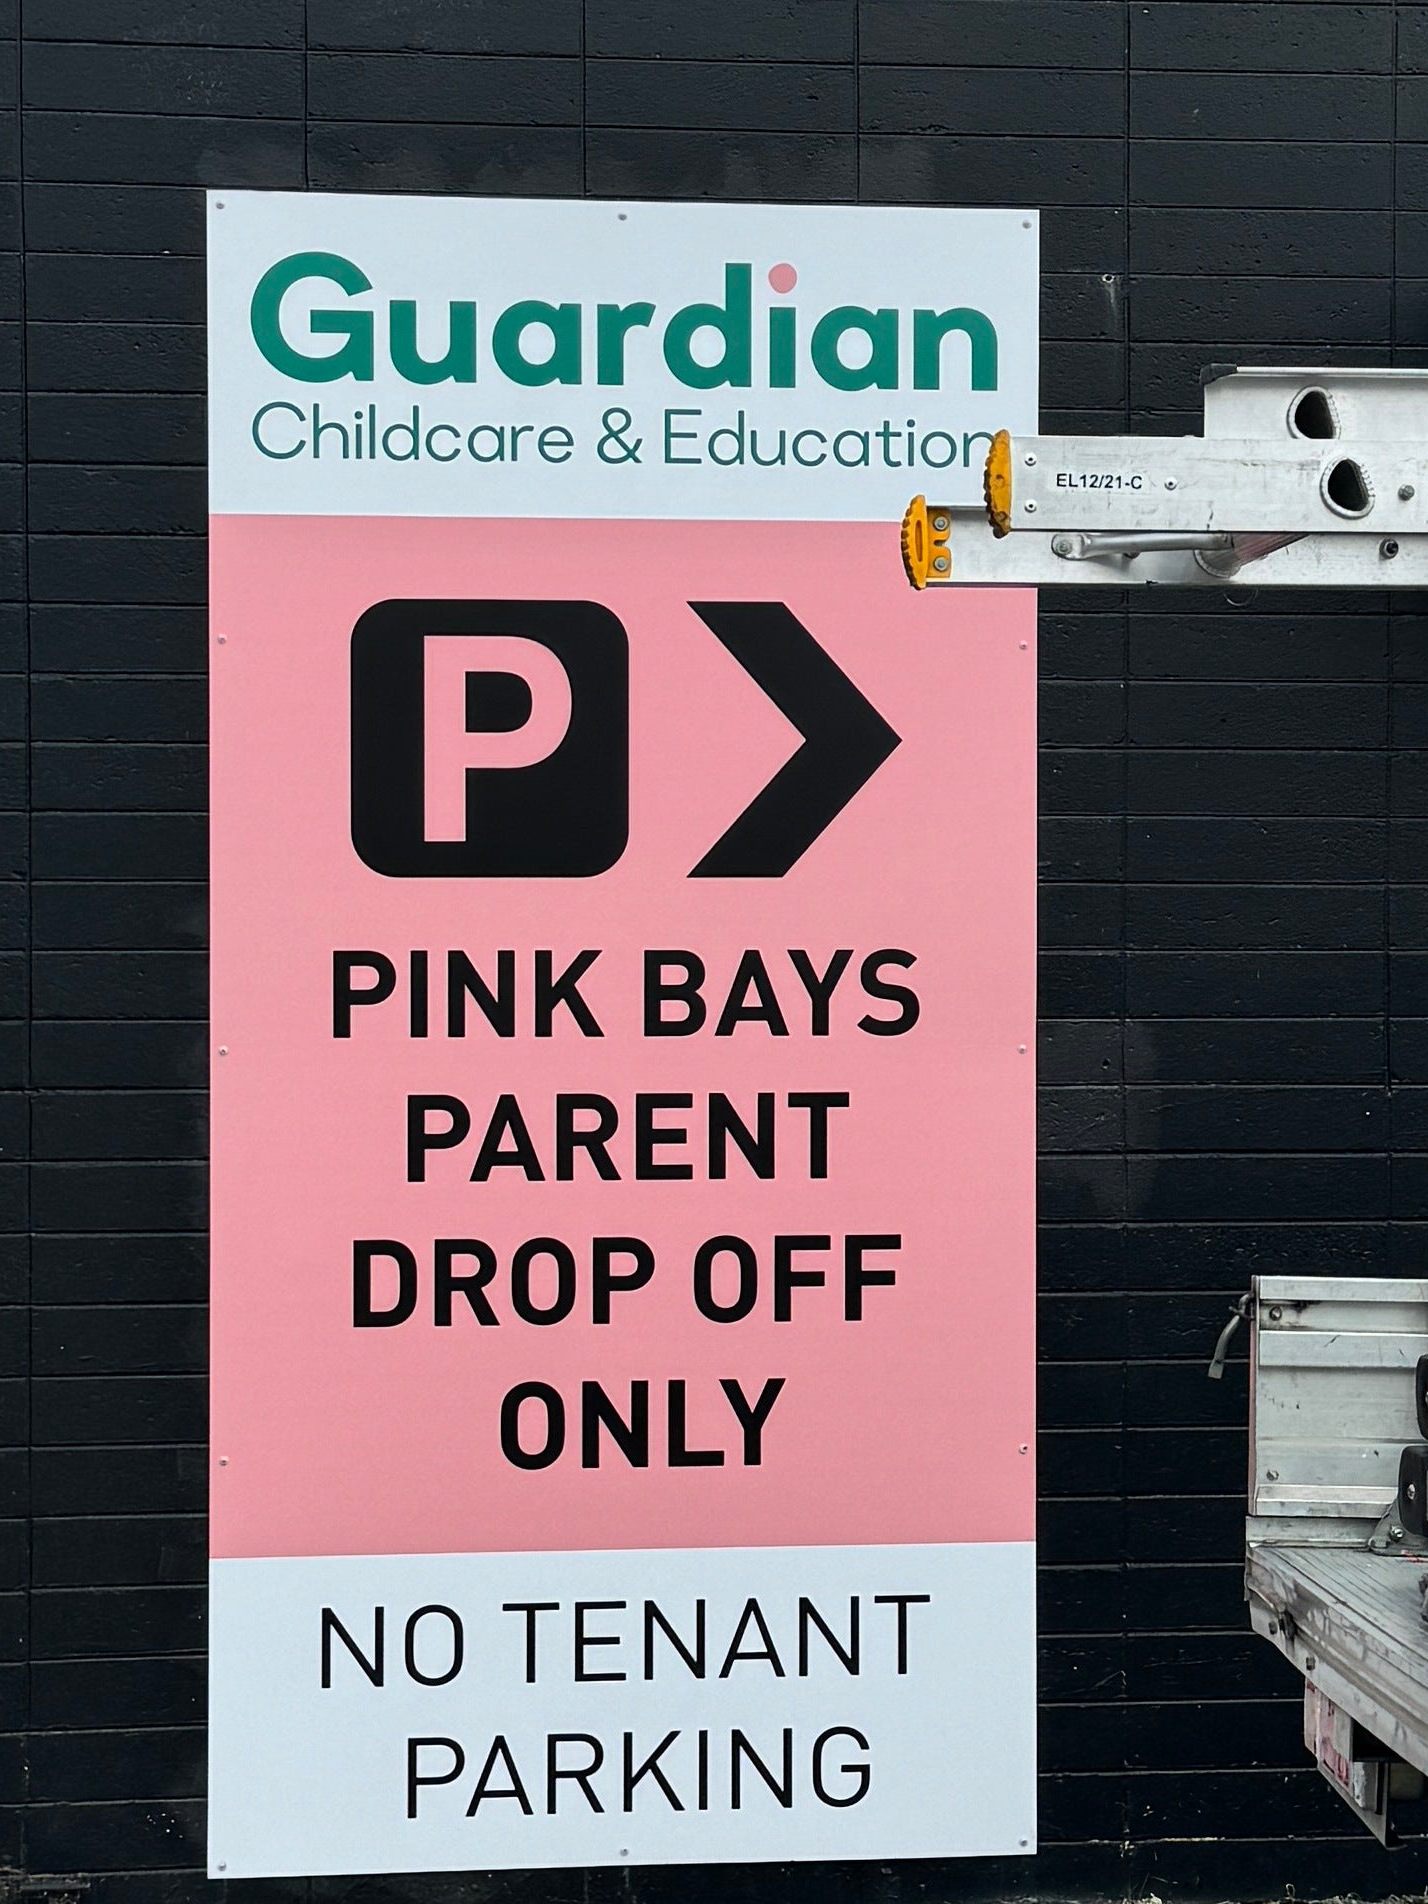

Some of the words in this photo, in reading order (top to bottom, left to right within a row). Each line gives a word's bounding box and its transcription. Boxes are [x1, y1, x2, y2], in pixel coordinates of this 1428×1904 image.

[251, 252, 997, 391] Guardian
[252, 402, 574, 463] Childcare
[597, 408, 642, 464] &
[665, 409, 994, 468] Education
[1057, 473, 1143, 490] EL12/21-C
[424, 636, 572, 842] P
[332, 949, 604, 1038] PINK
[643, 948, 920, 1037] BAYS
[407, 1091, 850, 1183] PARENT
[352, 1237, 655, 1328] DROP
[693, 1233, 902, 1324] OFF
[500, 1377, 785, 1470] ONLY
[321, 1605, 464, 1688] NO
[502, 1594, 931, 1684] TENANT
[407, 1726, 871, 1819] PARKING
